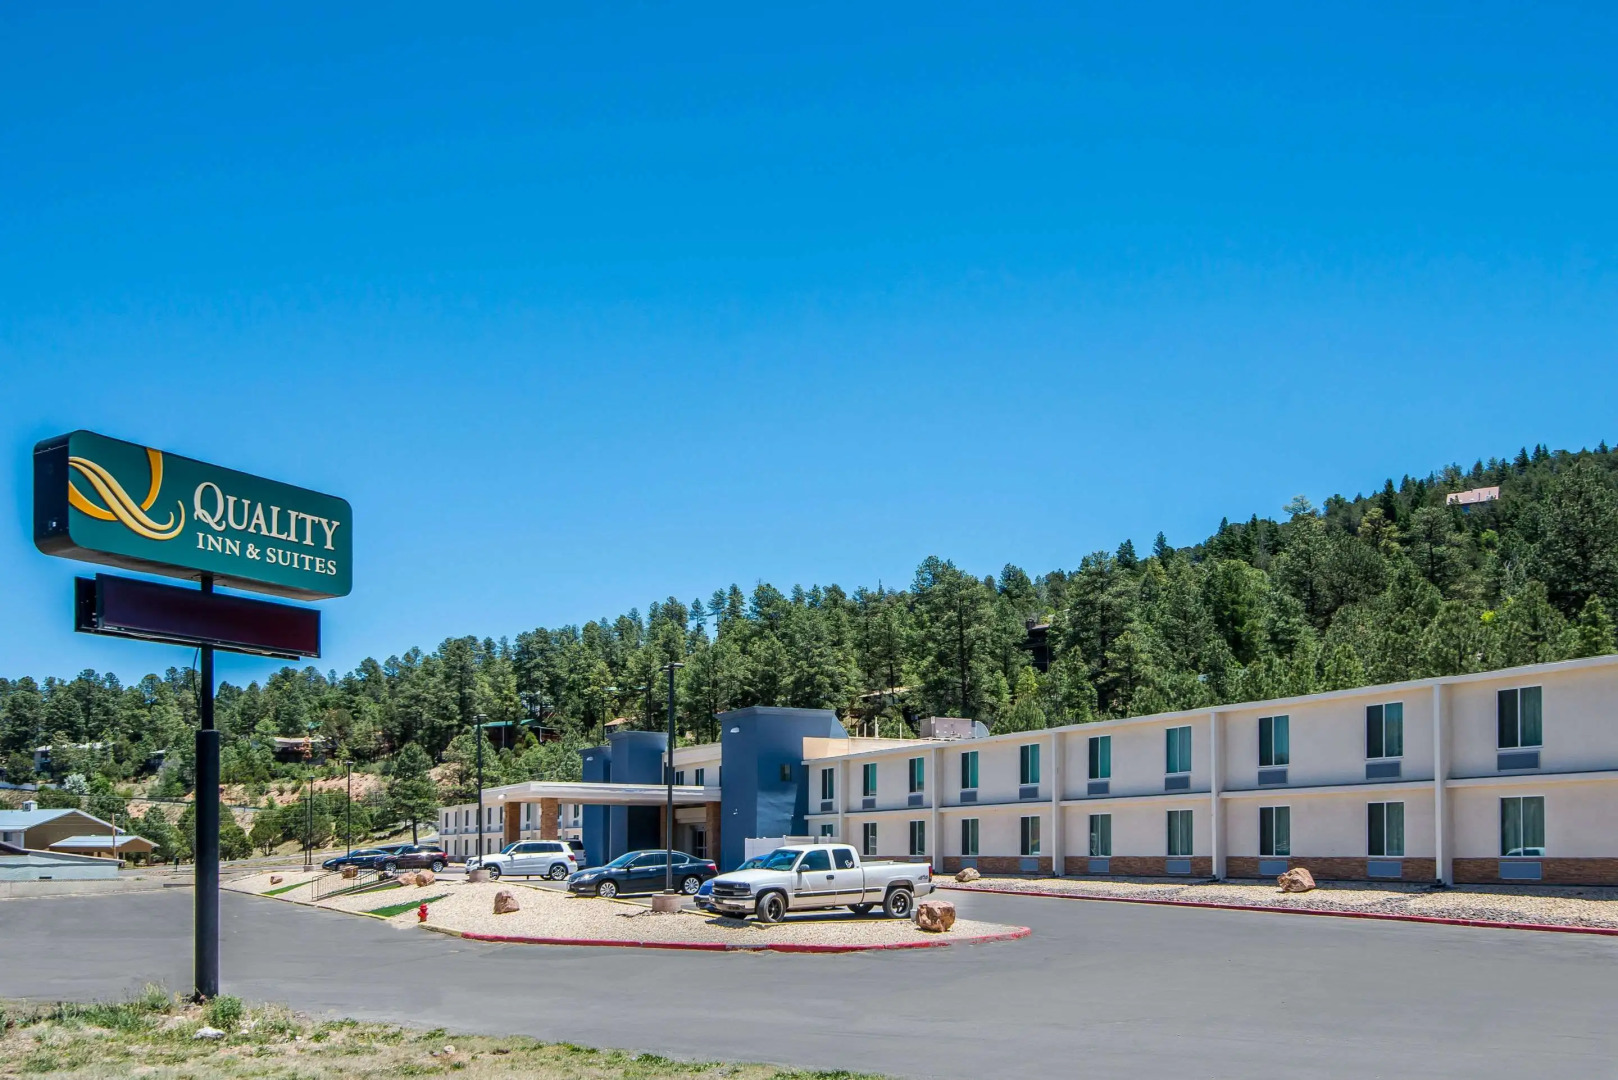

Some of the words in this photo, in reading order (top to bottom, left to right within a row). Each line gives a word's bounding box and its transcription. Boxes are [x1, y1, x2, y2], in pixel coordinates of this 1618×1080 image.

[193, 481, 340, 550] QUALITY
[196, 532, 241, 557] INN
[246, 543, 261, 560] &
[266, 547, 337, 576] SUITES
